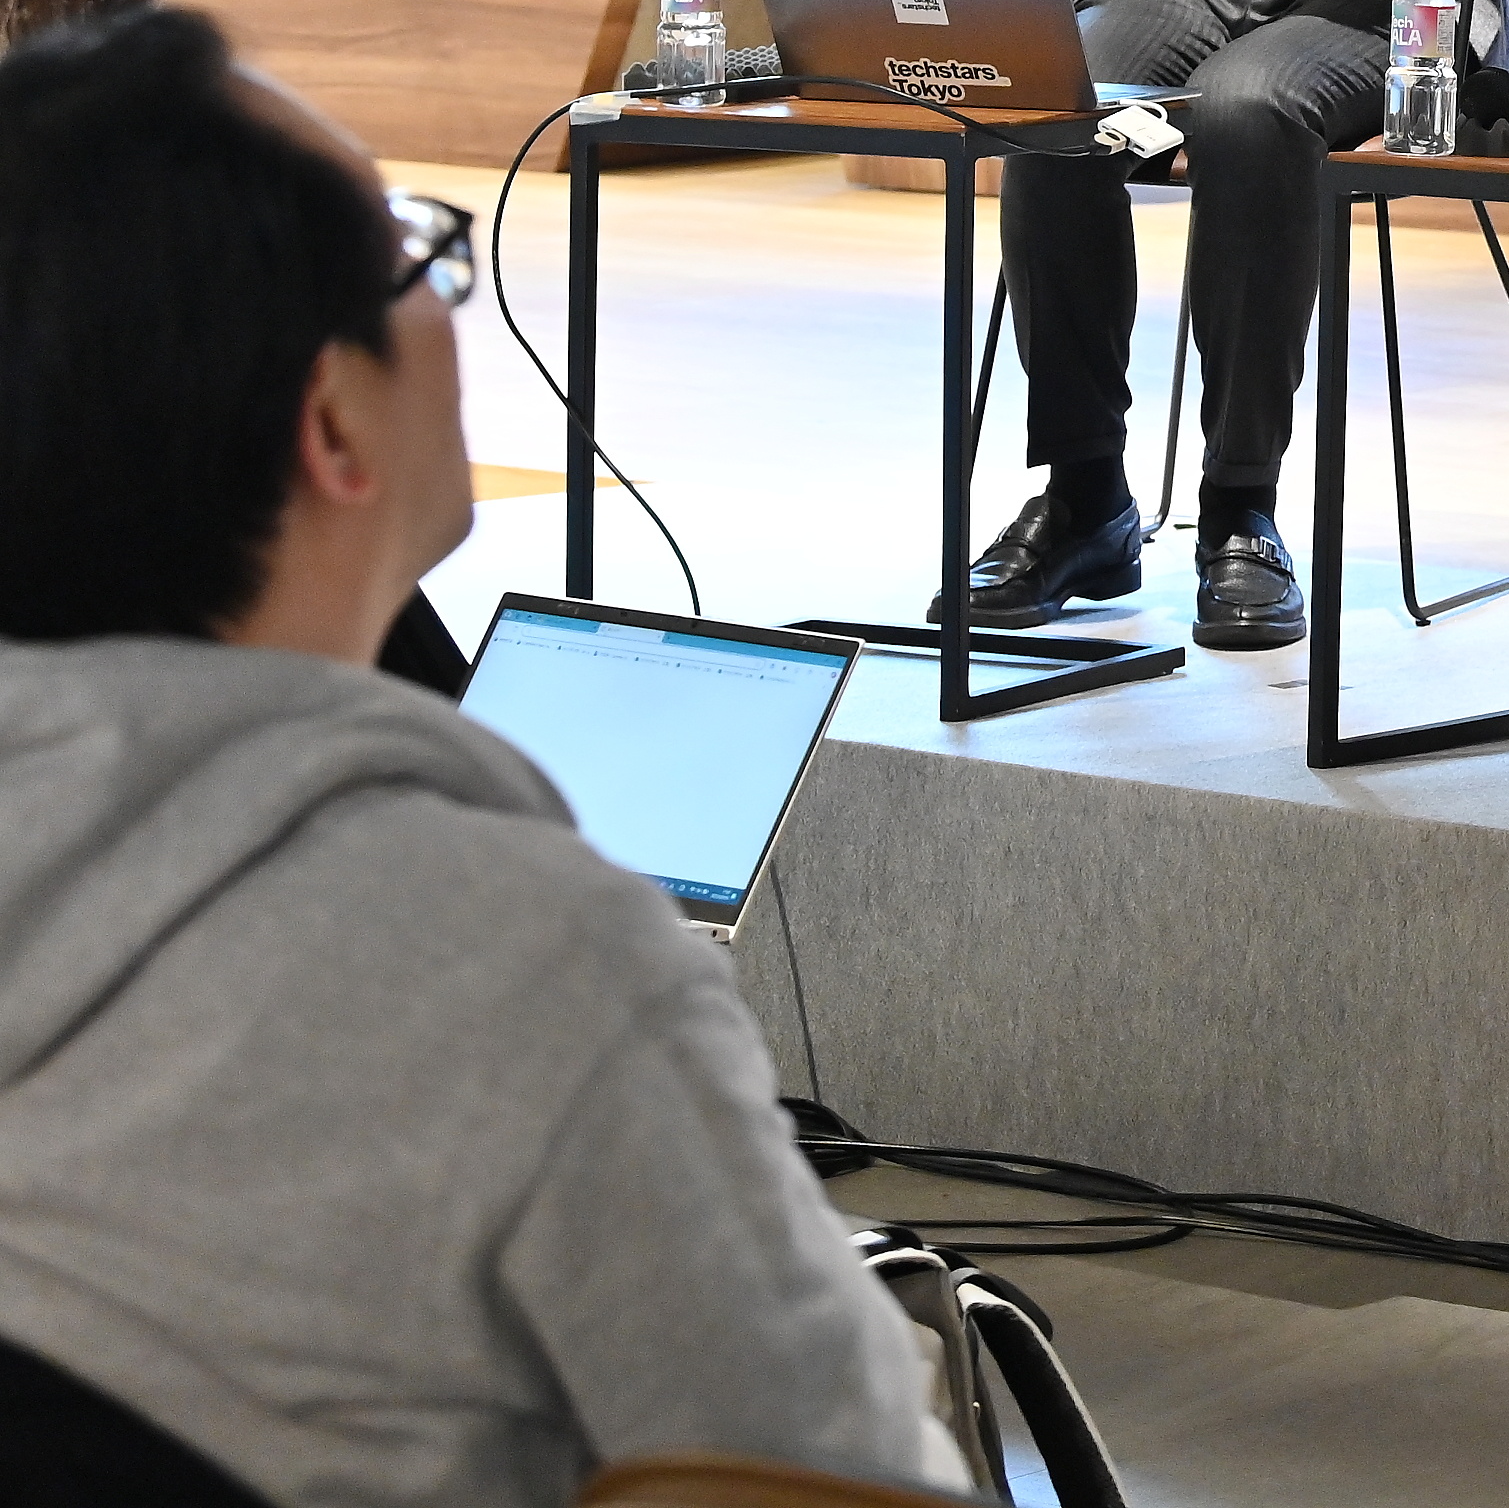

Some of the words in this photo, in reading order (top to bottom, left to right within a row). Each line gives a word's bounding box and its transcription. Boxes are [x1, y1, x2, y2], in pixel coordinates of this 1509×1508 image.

[1392, 15, 1414, 29] ech
[1392, 28, 1423, 47] ALA
[892, 78, 963, 101] Tokyo
